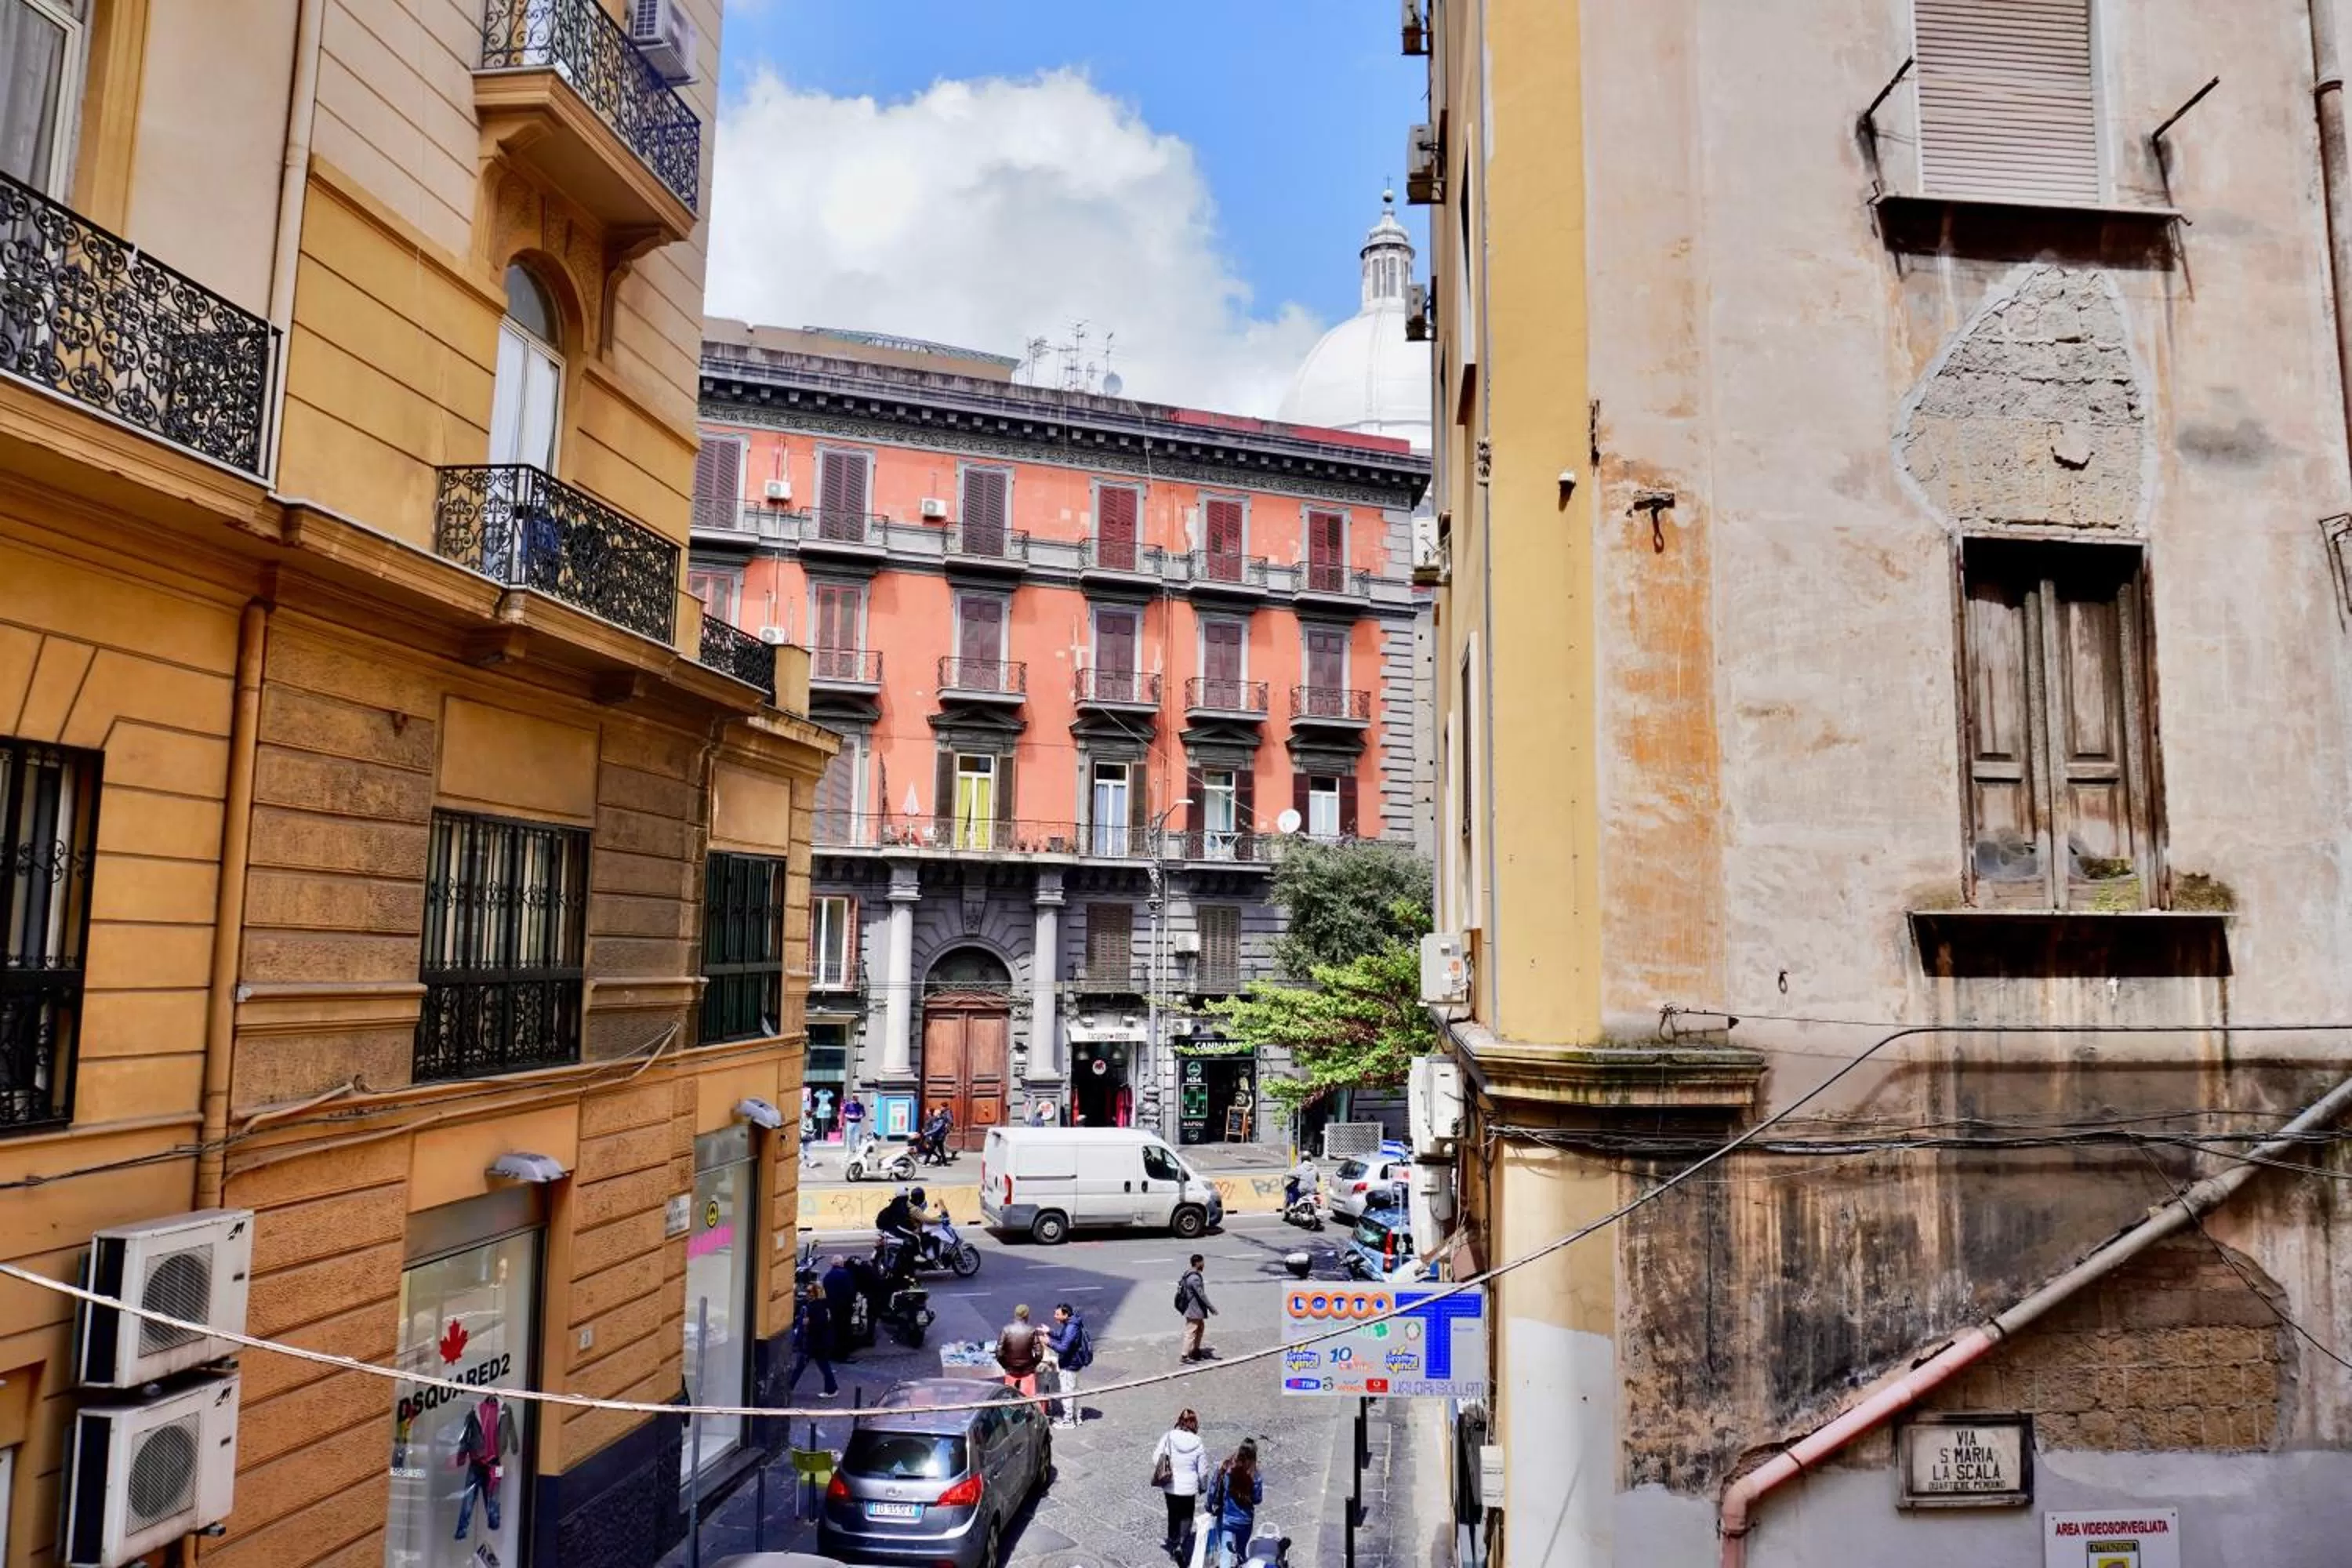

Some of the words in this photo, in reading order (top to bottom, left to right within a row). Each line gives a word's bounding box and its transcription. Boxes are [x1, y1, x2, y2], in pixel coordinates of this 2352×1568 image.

[1290, 1294, 1388, 1316] LOTTO
[1956, 1430, 1976, 1446] VIA
[1940, 1448, 1948, 1464] S
[1955, 1446, 1993, 1463] MARIA
[1933, 1465, 1951, 1481] LA
[1956, 1461, 2001, 1480] SCALA
[2056, 1521, 2081, 1537] AREA
[2082, 1519, 2169, 1536] VIDEOSORVEGLIATA
